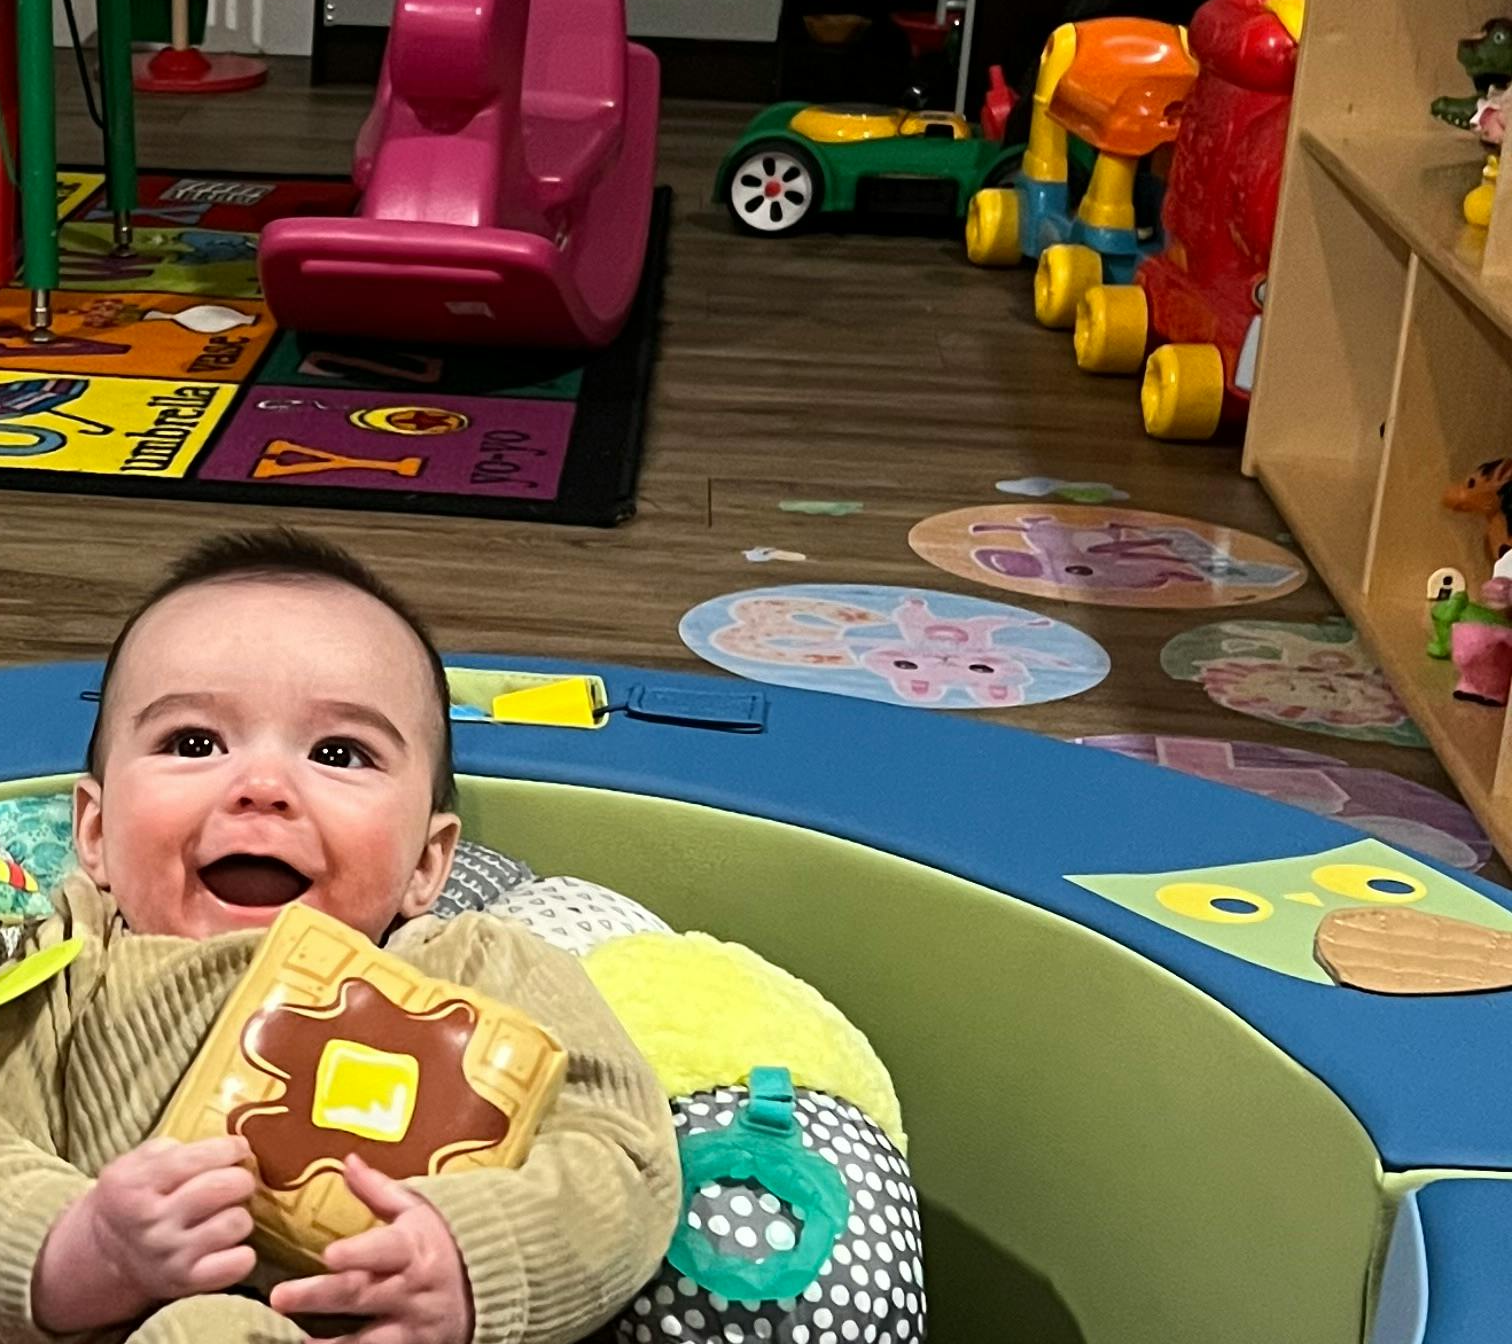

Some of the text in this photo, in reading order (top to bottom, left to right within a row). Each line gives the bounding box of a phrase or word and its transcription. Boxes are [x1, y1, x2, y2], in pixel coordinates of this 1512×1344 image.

[118, 382, 221, 475] umbrella
[251, 429, 548, 488] Y yo-yo
